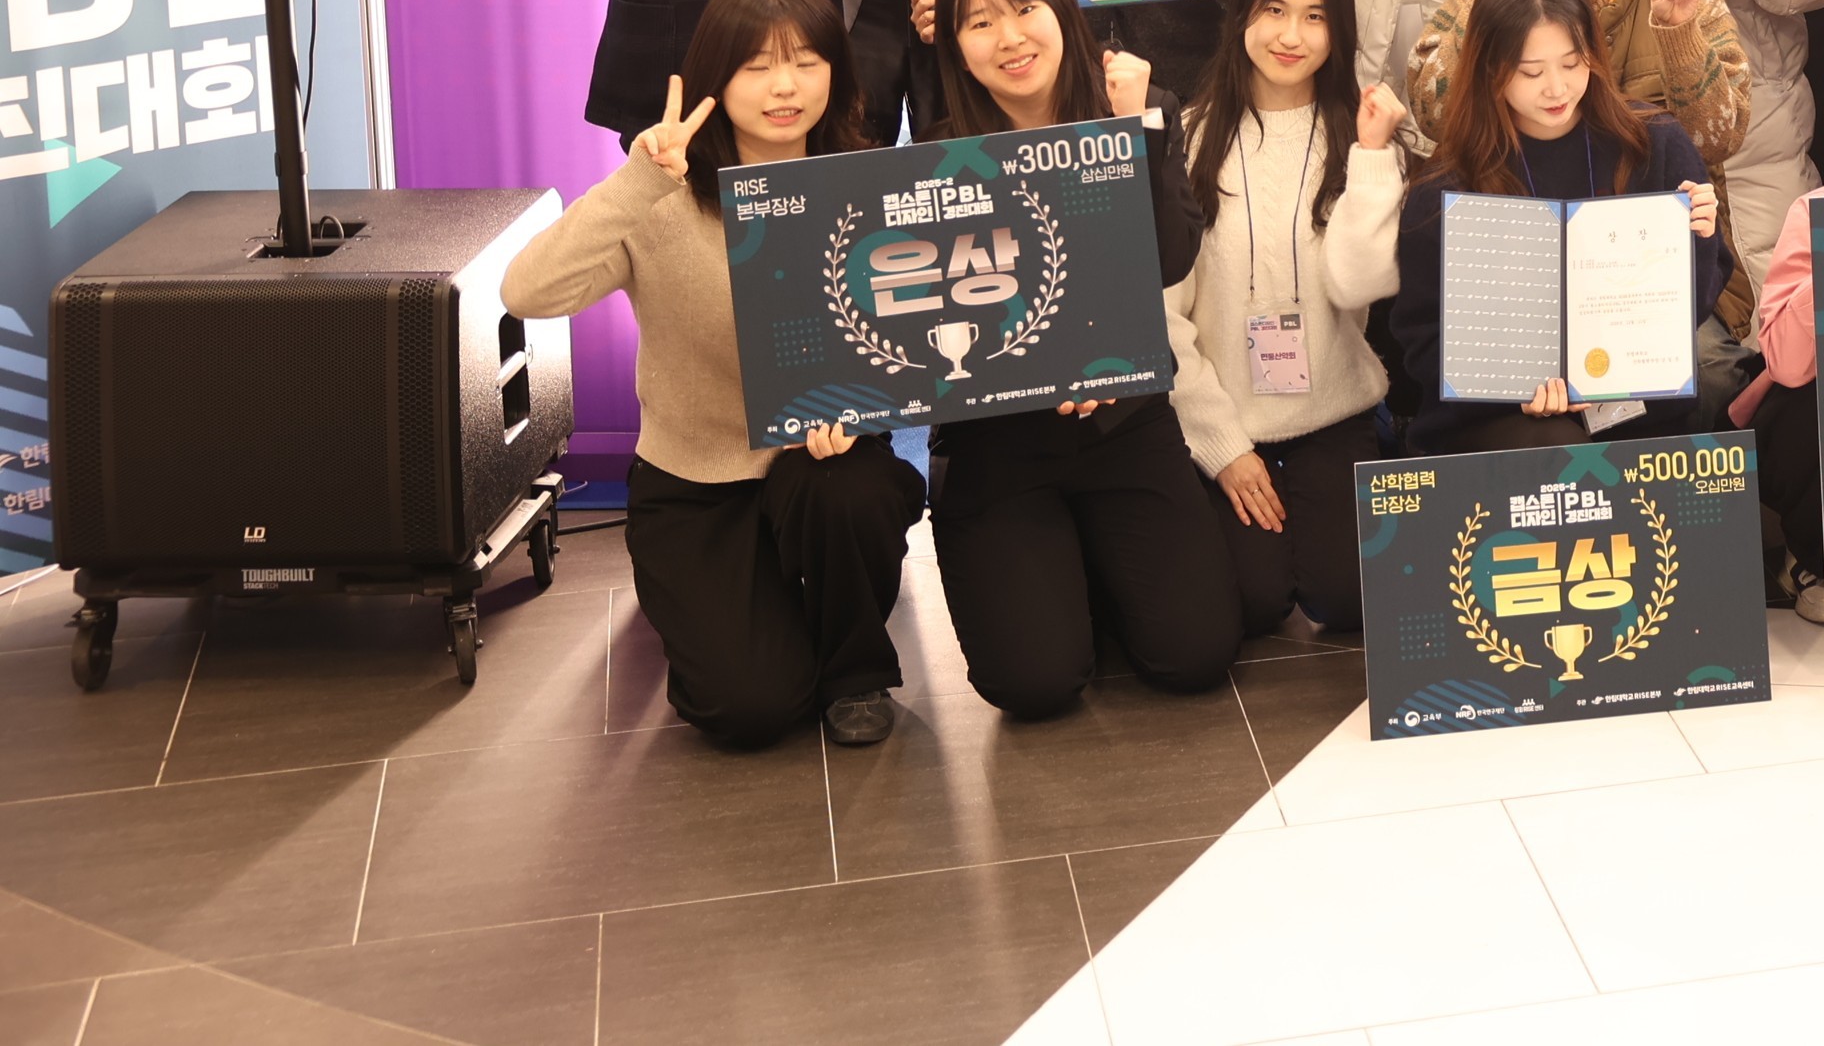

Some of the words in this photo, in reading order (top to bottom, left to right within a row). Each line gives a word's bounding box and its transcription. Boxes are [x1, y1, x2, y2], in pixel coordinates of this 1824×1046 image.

[1002, 132, 1133, 175] ₩300,000
[1081, 163, 1135, 184] 삼십만원
[734, 179, 768, 197] RISE
[915, 178, 954, 189] 2025-2
[883, 190, 932, 211] 캡스톤
[942, 184, 992, 204] PBL
[737, 195, 806, 220] 본부장상
[942, 202, 994, 220] 경진대회
[885, 209, 934, 227] 디자인
[870, 227, 1020, 317] 은상
[838, 416, 855, 424] NRF
[1624, 446, 1745, 483] ₩500,000
[1370, 470, 1436, 493] 산학협력
[1540, 483, 1577, 492] 2025-2
[1695, 477, 1745, 495] 오십만원
[1372, 494, 1421, 515] 단장상
[1510, 494, 1556, 511] 캡스톤
[1565, 490, 1610, 509] PBL
[1511, 511, 1556, 528] 디자인
[1566, 508, 1612, 524] 경진대회
[244, 527, 266, 539] LD
[241, 568, 315, 582] TOUGHBUILT
[1492, 533, 1636, 617] 금상
[243, 582, 279, 590] STACKTECH
[1423, 713, 1441, 722] 교육부
